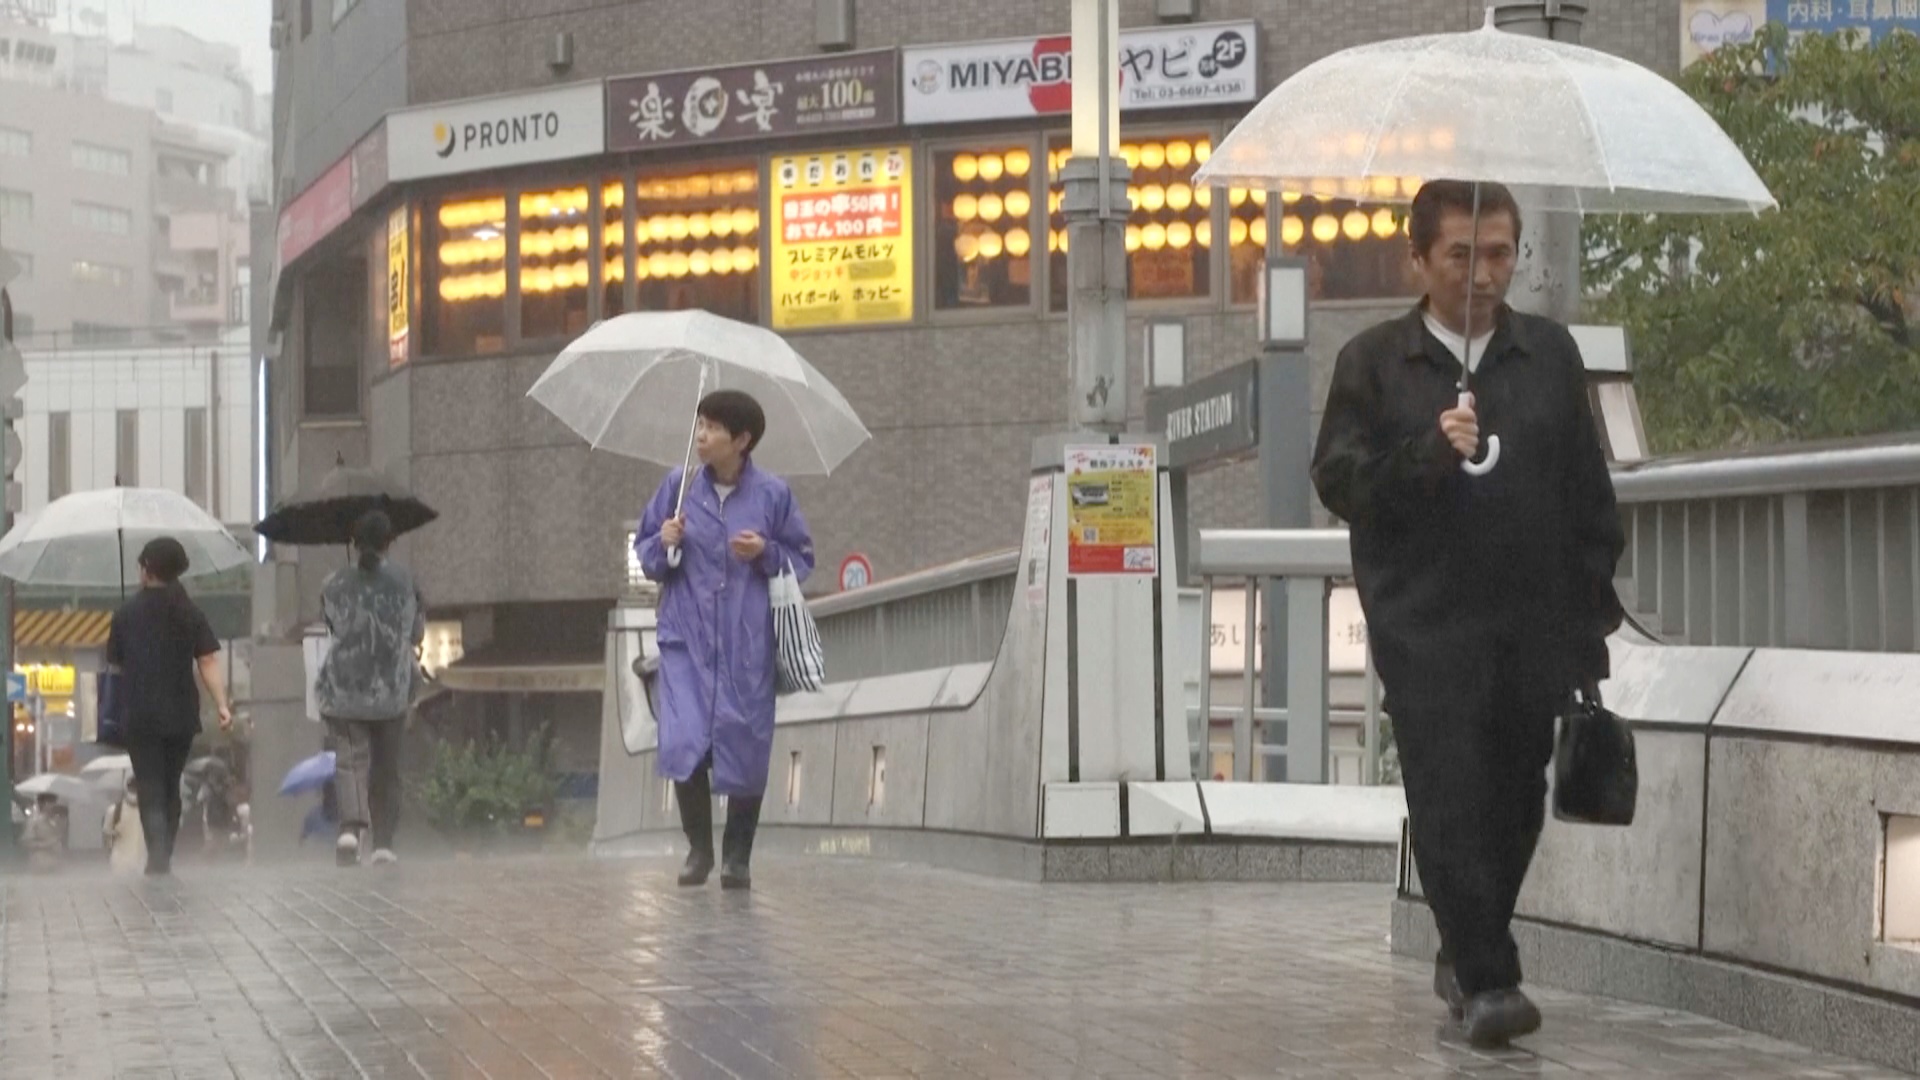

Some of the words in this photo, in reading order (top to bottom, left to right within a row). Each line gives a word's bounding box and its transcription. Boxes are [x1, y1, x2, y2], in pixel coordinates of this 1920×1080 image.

[1119, 36, 1197, 82] ヤビ
[1215, 38, 1243, 61] 2F
[464, 111, 559, 151] PRONTO
[1194, 392, 1232, 435] STATION
